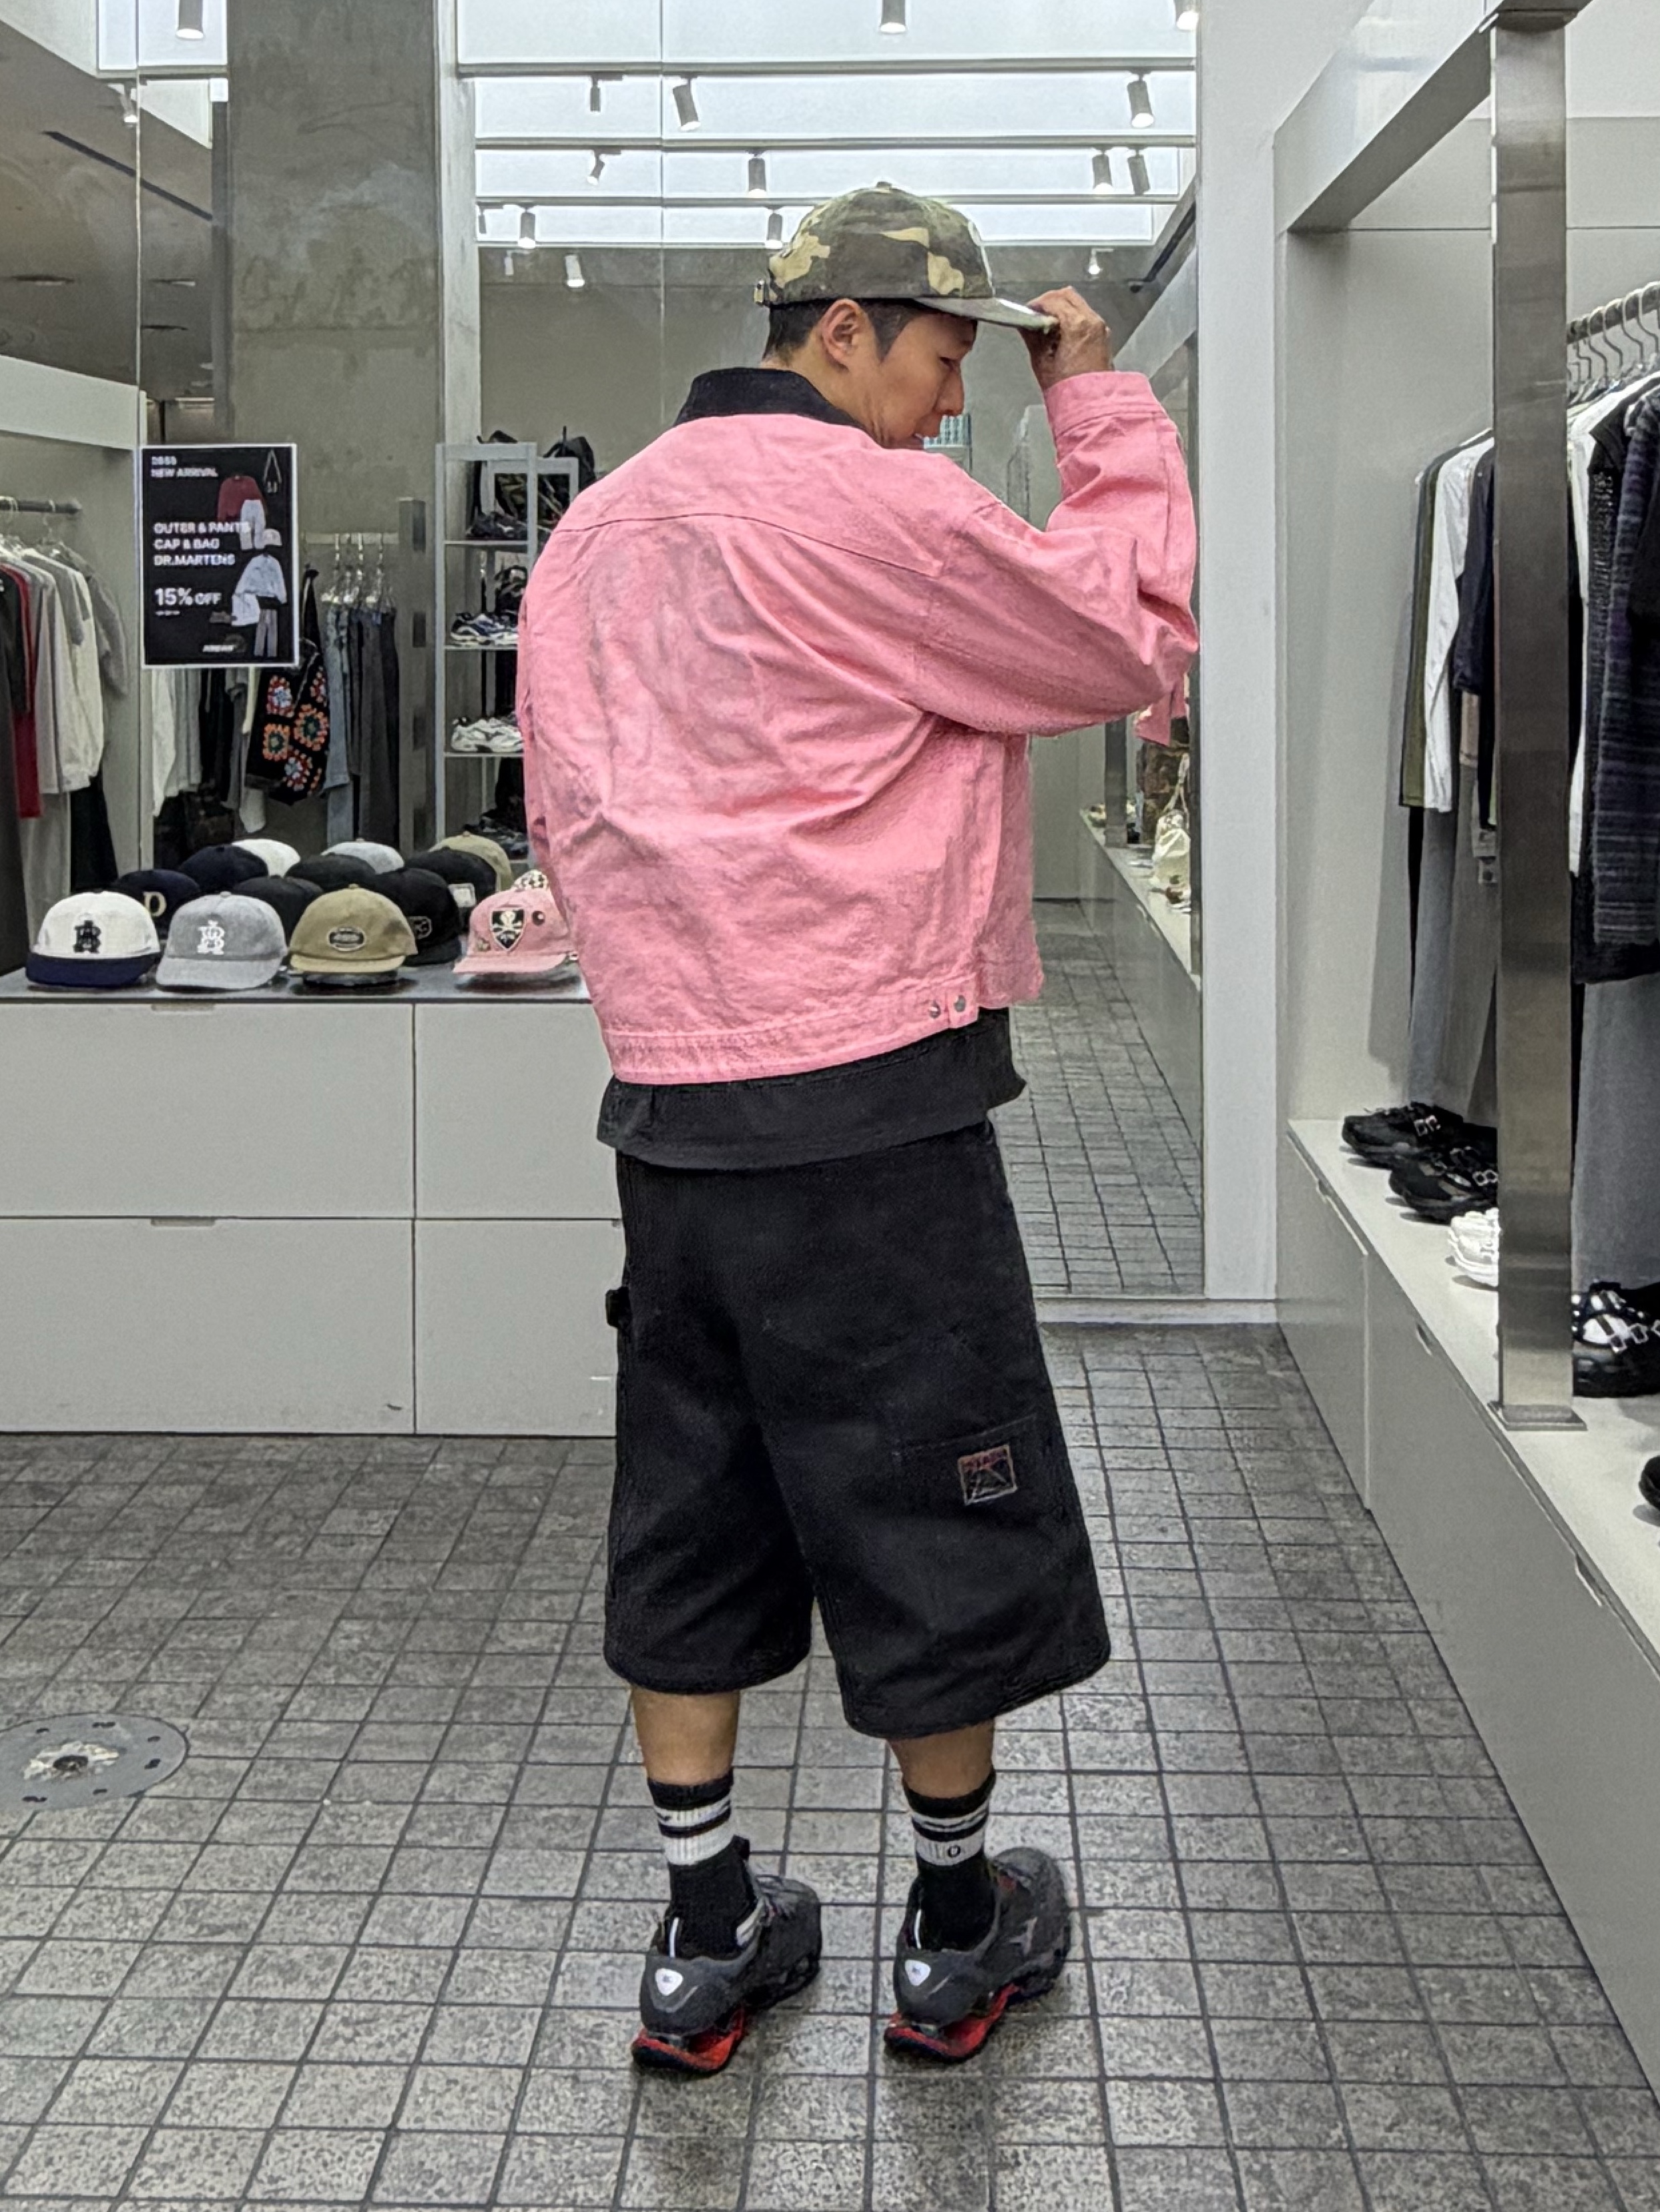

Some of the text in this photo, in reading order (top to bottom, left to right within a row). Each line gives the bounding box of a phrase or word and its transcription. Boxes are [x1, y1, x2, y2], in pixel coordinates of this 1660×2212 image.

[154, 522, 196, 533] OUTER
[154, 538, 181, 550] CAP
[155, 588, 222, 605] 15% OFF
